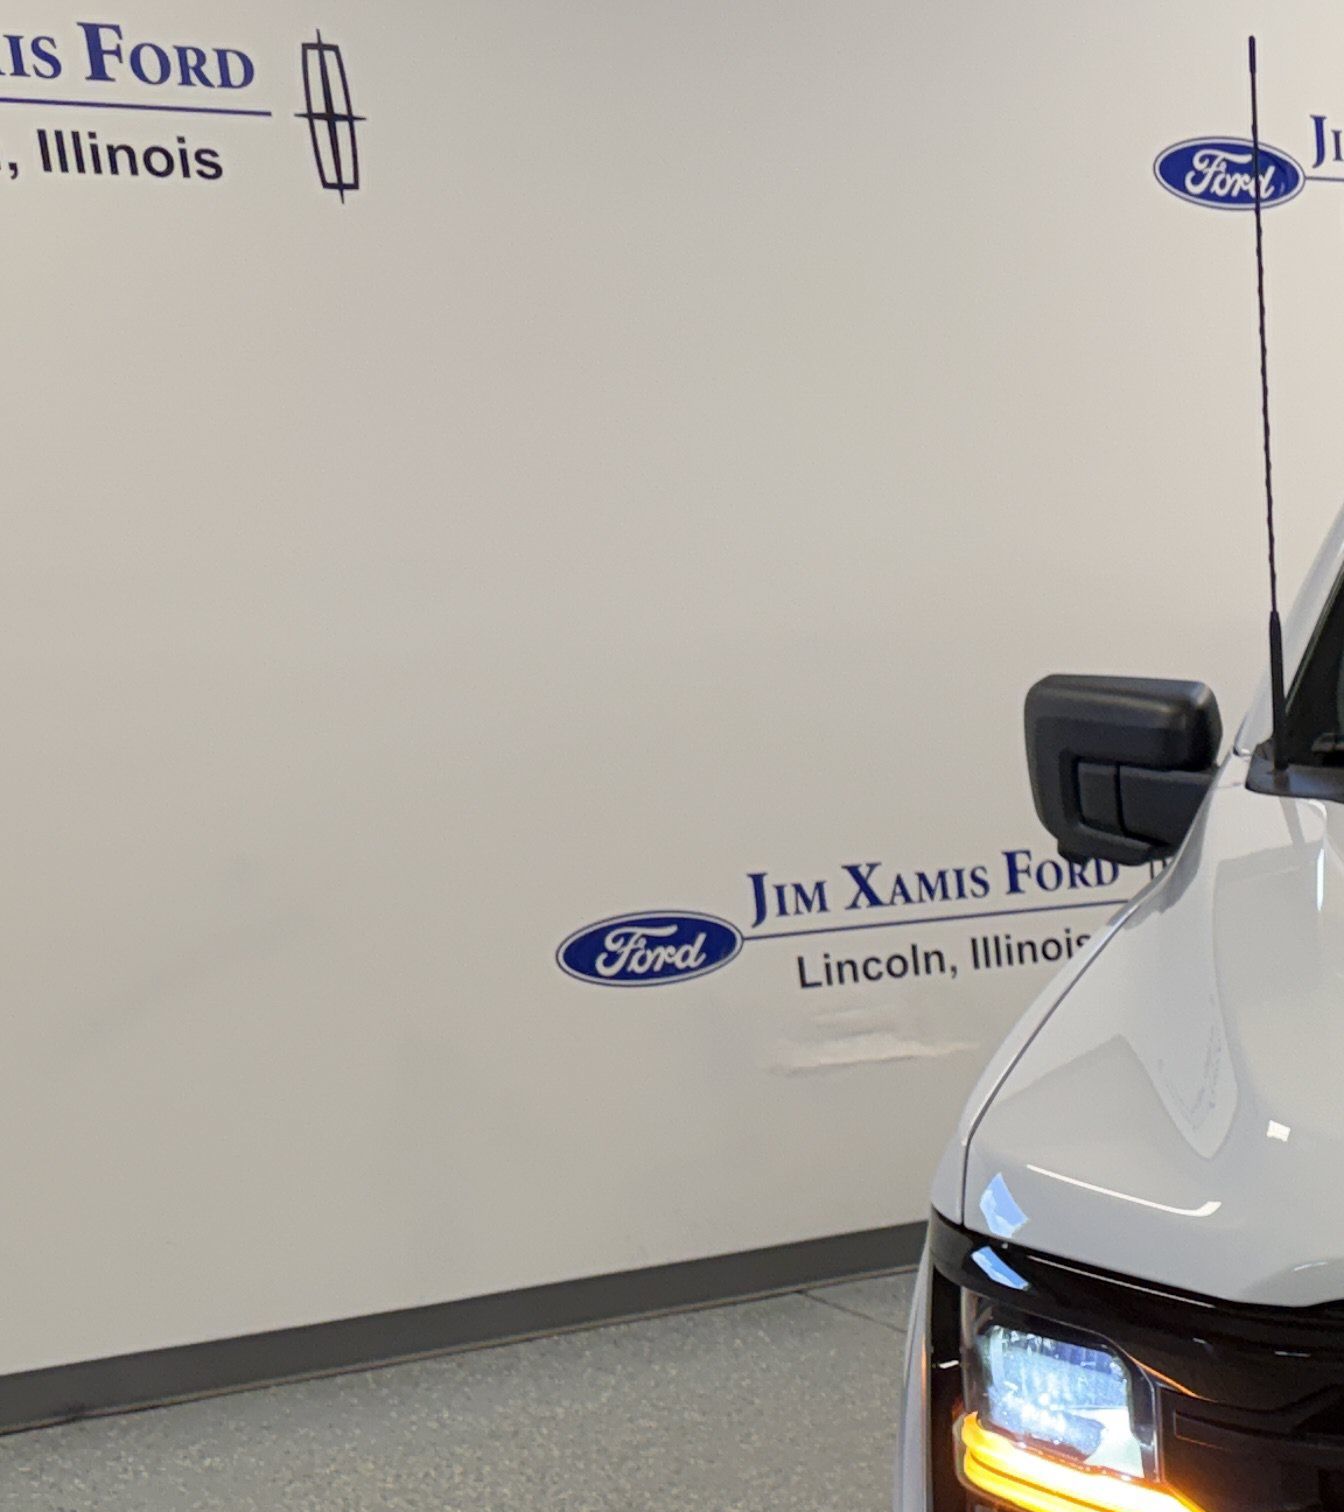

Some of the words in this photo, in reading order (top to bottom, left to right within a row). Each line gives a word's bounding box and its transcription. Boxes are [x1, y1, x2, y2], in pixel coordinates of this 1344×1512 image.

[0, 34, 62, 80] IS
[77, 22, 255, 89] FORD
[38, 128, 223, 180] Illinois
[1185, 149, 1275, 198] Ford
[747, 872, 827, 928] JIM
[841, 861, 990, 908] XAMIS
[1001, 849, 1120, 895] FORD
[595, 925, 707, 976] Ford
[798, 944, 959, 989] Lincoln,
